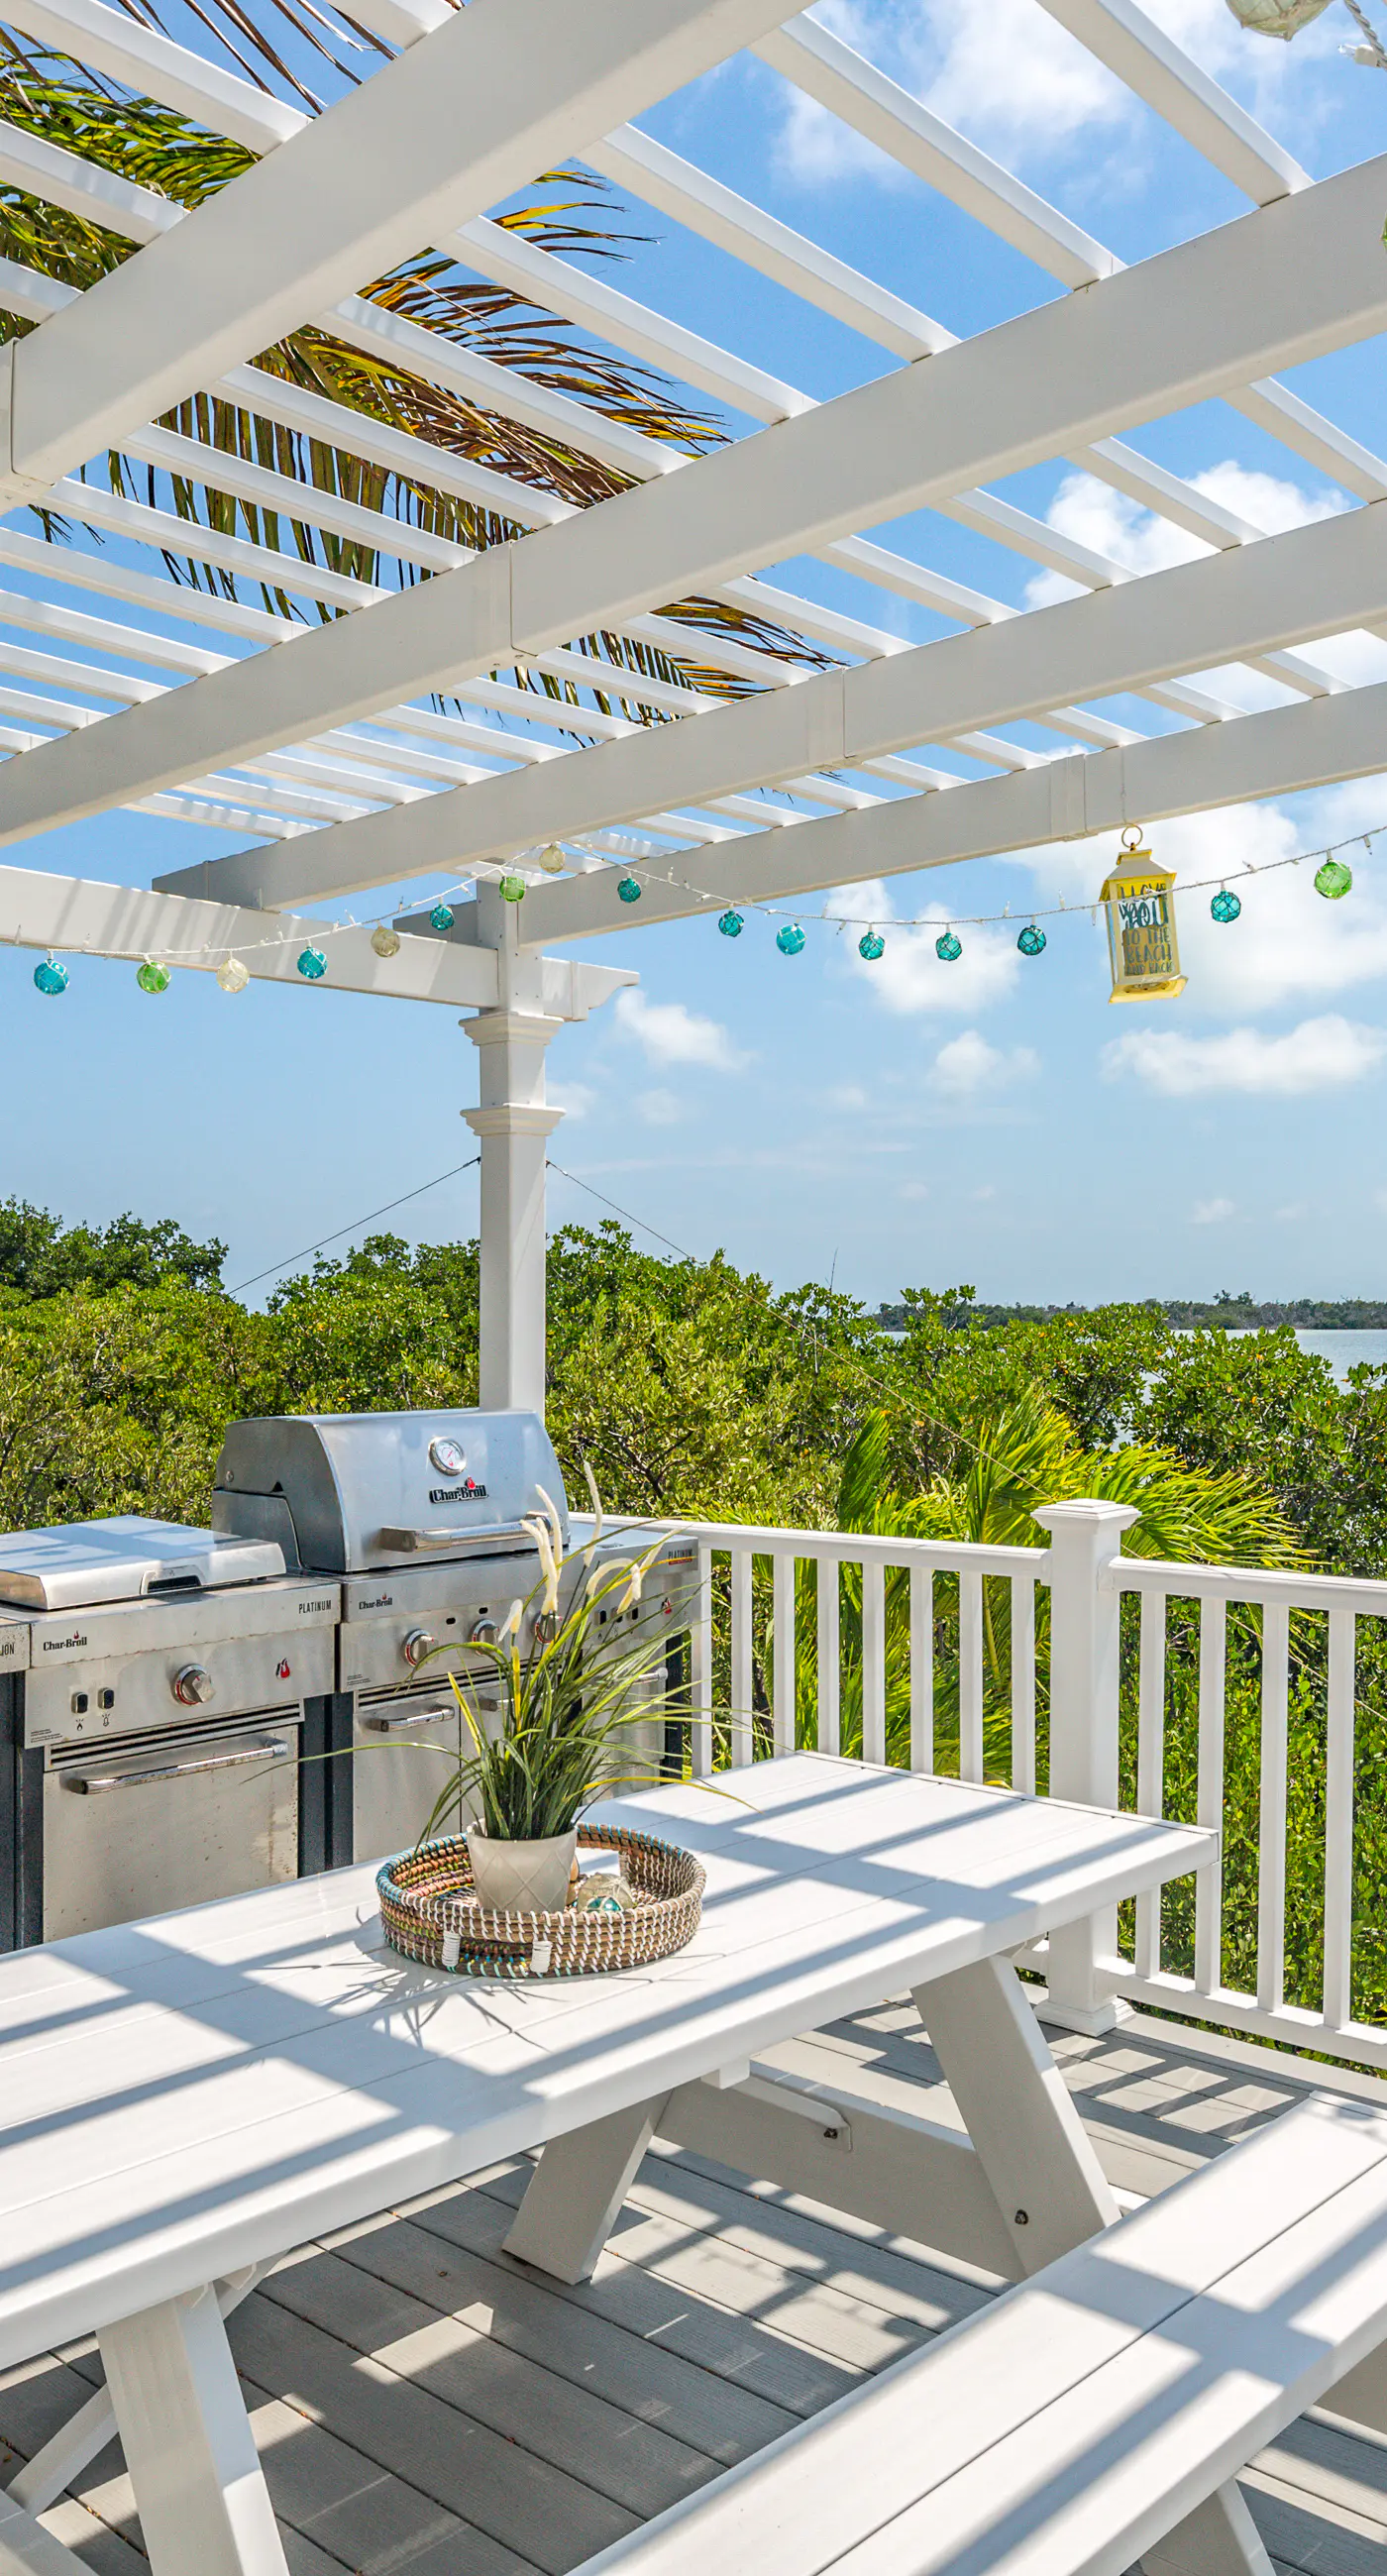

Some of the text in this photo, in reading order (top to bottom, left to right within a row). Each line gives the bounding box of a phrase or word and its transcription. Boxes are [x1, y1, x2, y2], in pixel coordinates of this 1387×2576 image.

[1124, 925, 1171, 945] TO THE
[1125, 943, 1172, 964] BEACH
[1149, 961, 1173, 975] BACK
[430, 1484, 487, 1503] Char-Broil
[298, 1599, 332, 1614] PLATINUM
[358, 1597, 393, 1610] Char-Broil
[43, 1636, 87, 1652] Char-Broil
